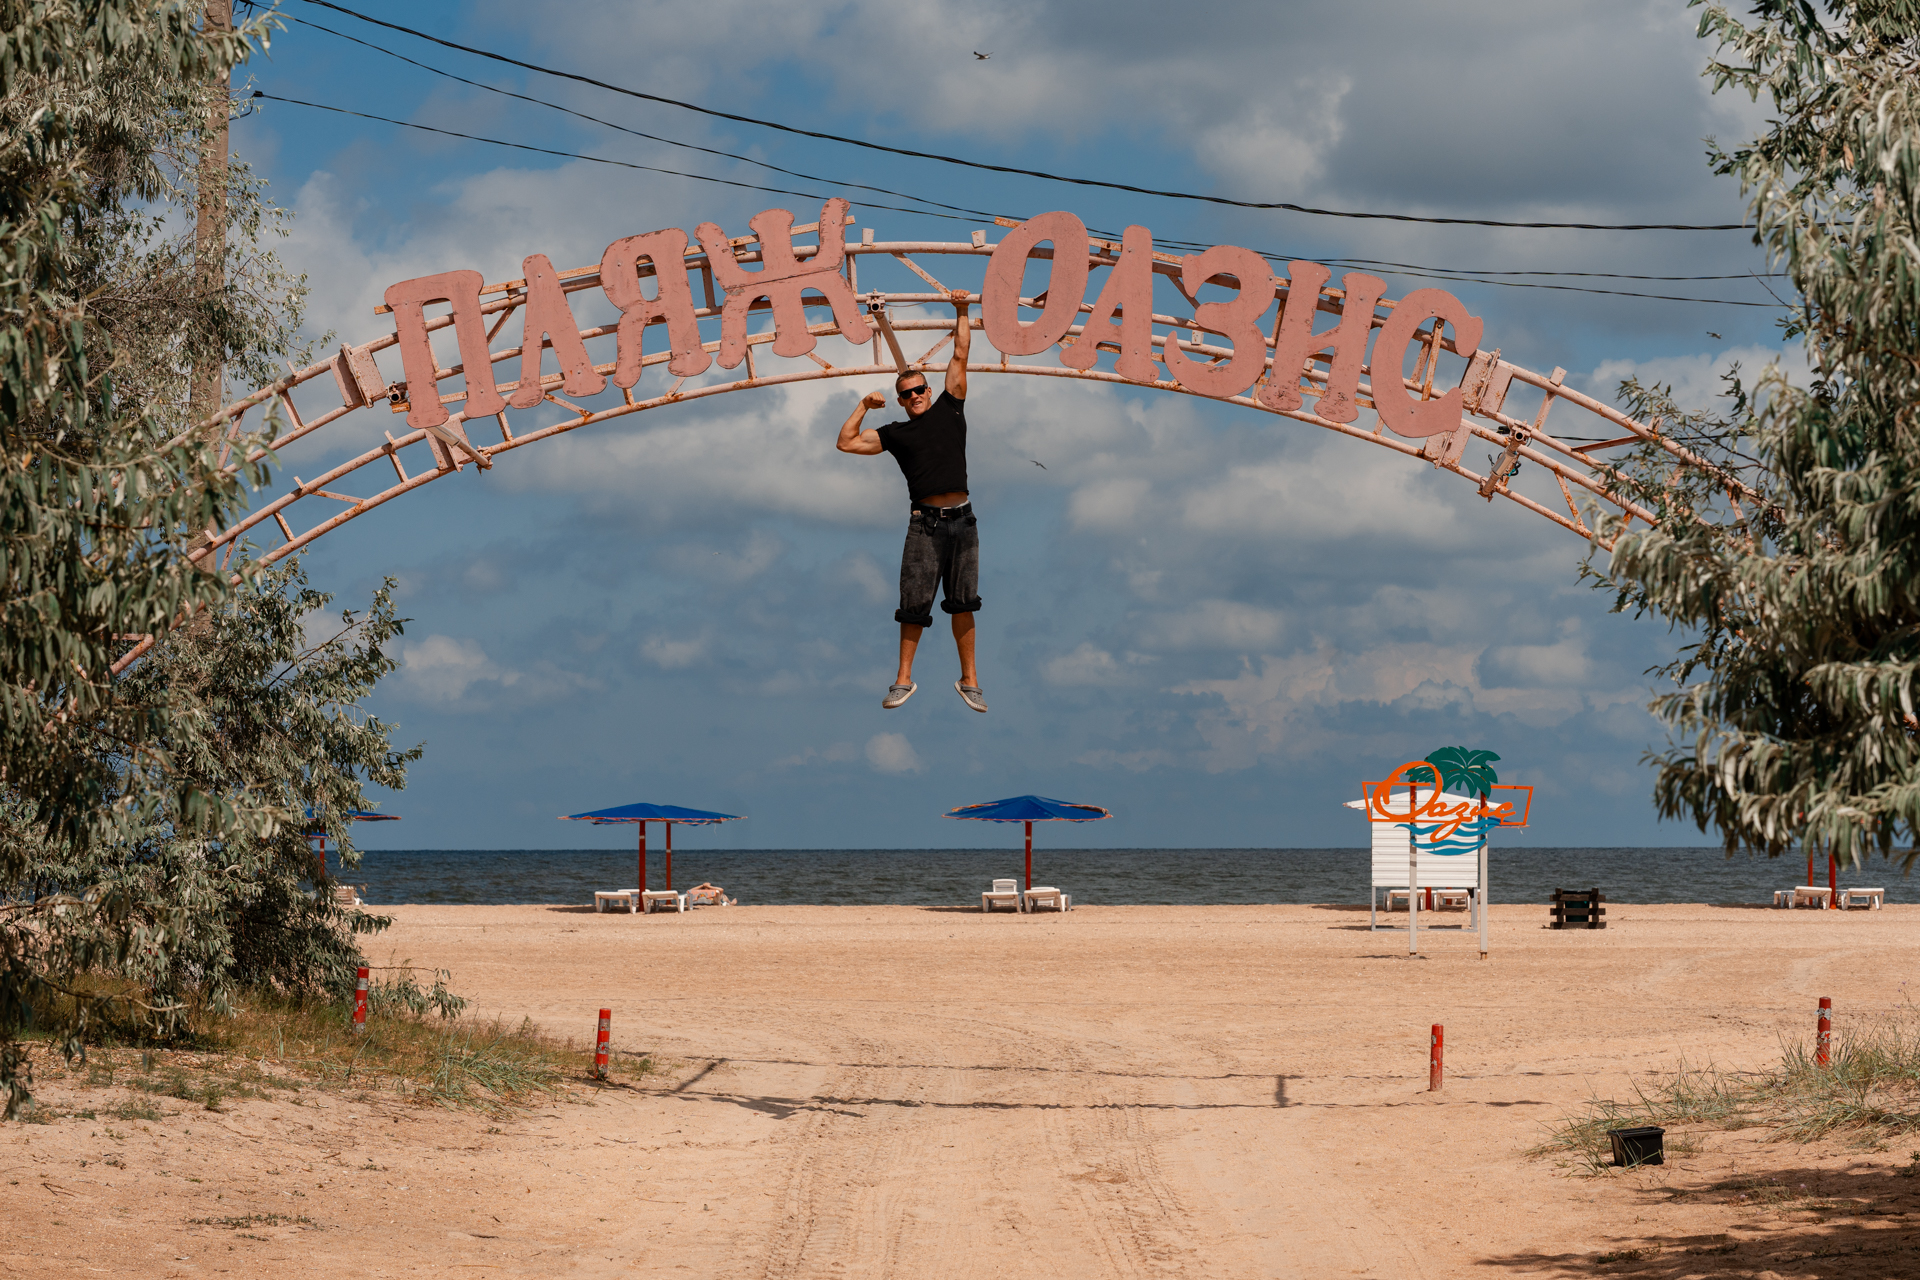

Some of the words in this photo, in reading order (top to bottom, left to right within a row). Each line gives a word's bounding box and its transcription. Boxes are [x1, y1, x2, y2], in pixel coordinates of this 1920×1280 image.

[384, 197, 874, 428] ПЛЯЖ
[982, 211, 1483, 438] ОАЗИС
[1372, 761, 1516, 843] Оазис
